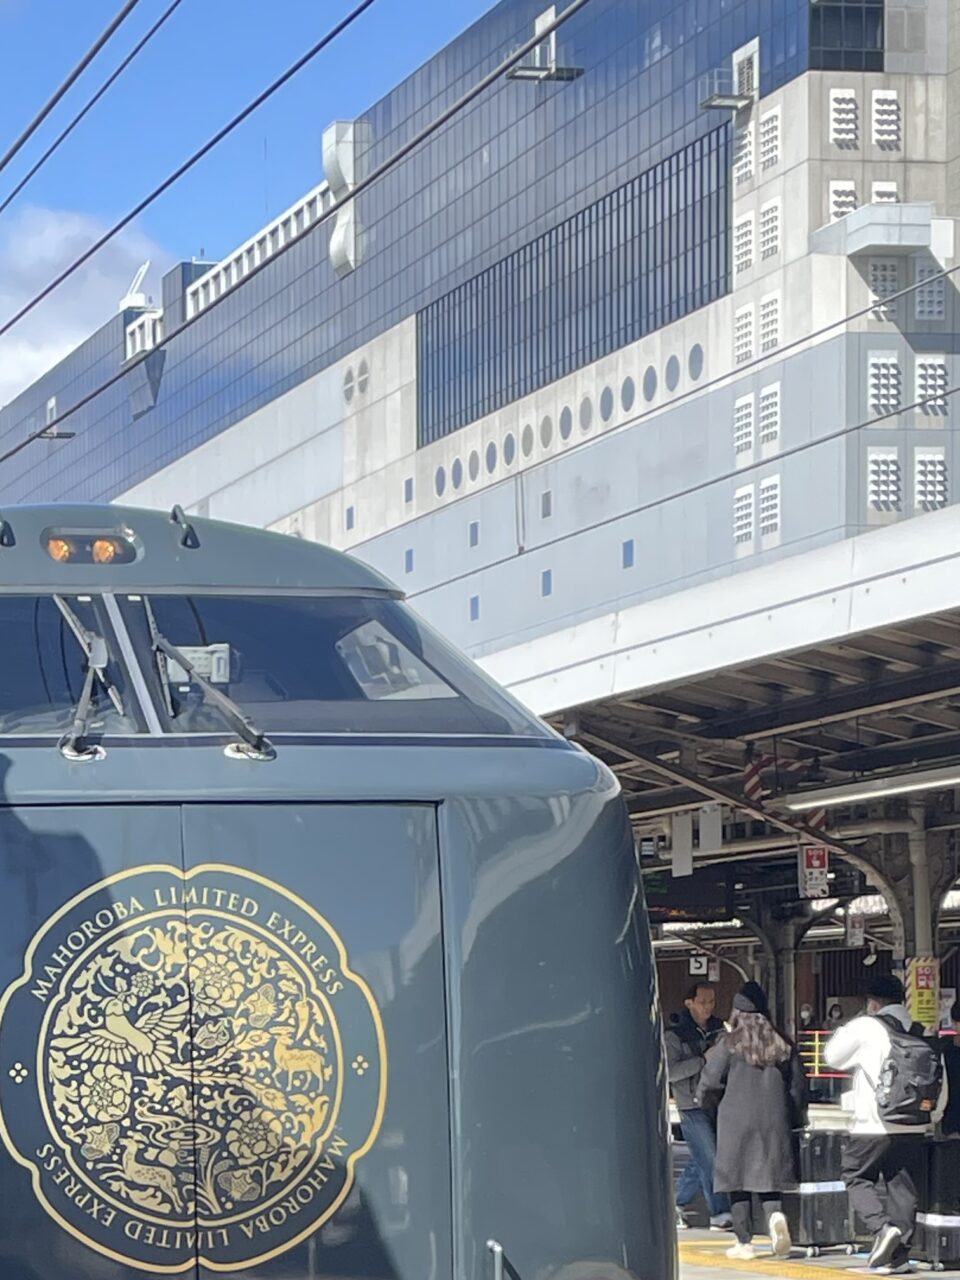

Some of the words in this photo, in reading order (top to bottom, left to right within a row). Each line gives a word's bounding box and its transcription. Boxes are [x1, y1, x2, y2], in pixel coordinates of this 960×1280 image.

[31, 896, 144, 1001] MAHOROBA
[154, 886, 259, 917] LIMITED
[266, 911, 344, 995] EXPRESS
[693, 957, 703, 969] 5
[36, 1144, 117, 1227] EXPRESS
[240, 1135, 349, 1239] MAHOROBA
[124, 1220, 230, 1249] LIMITED
